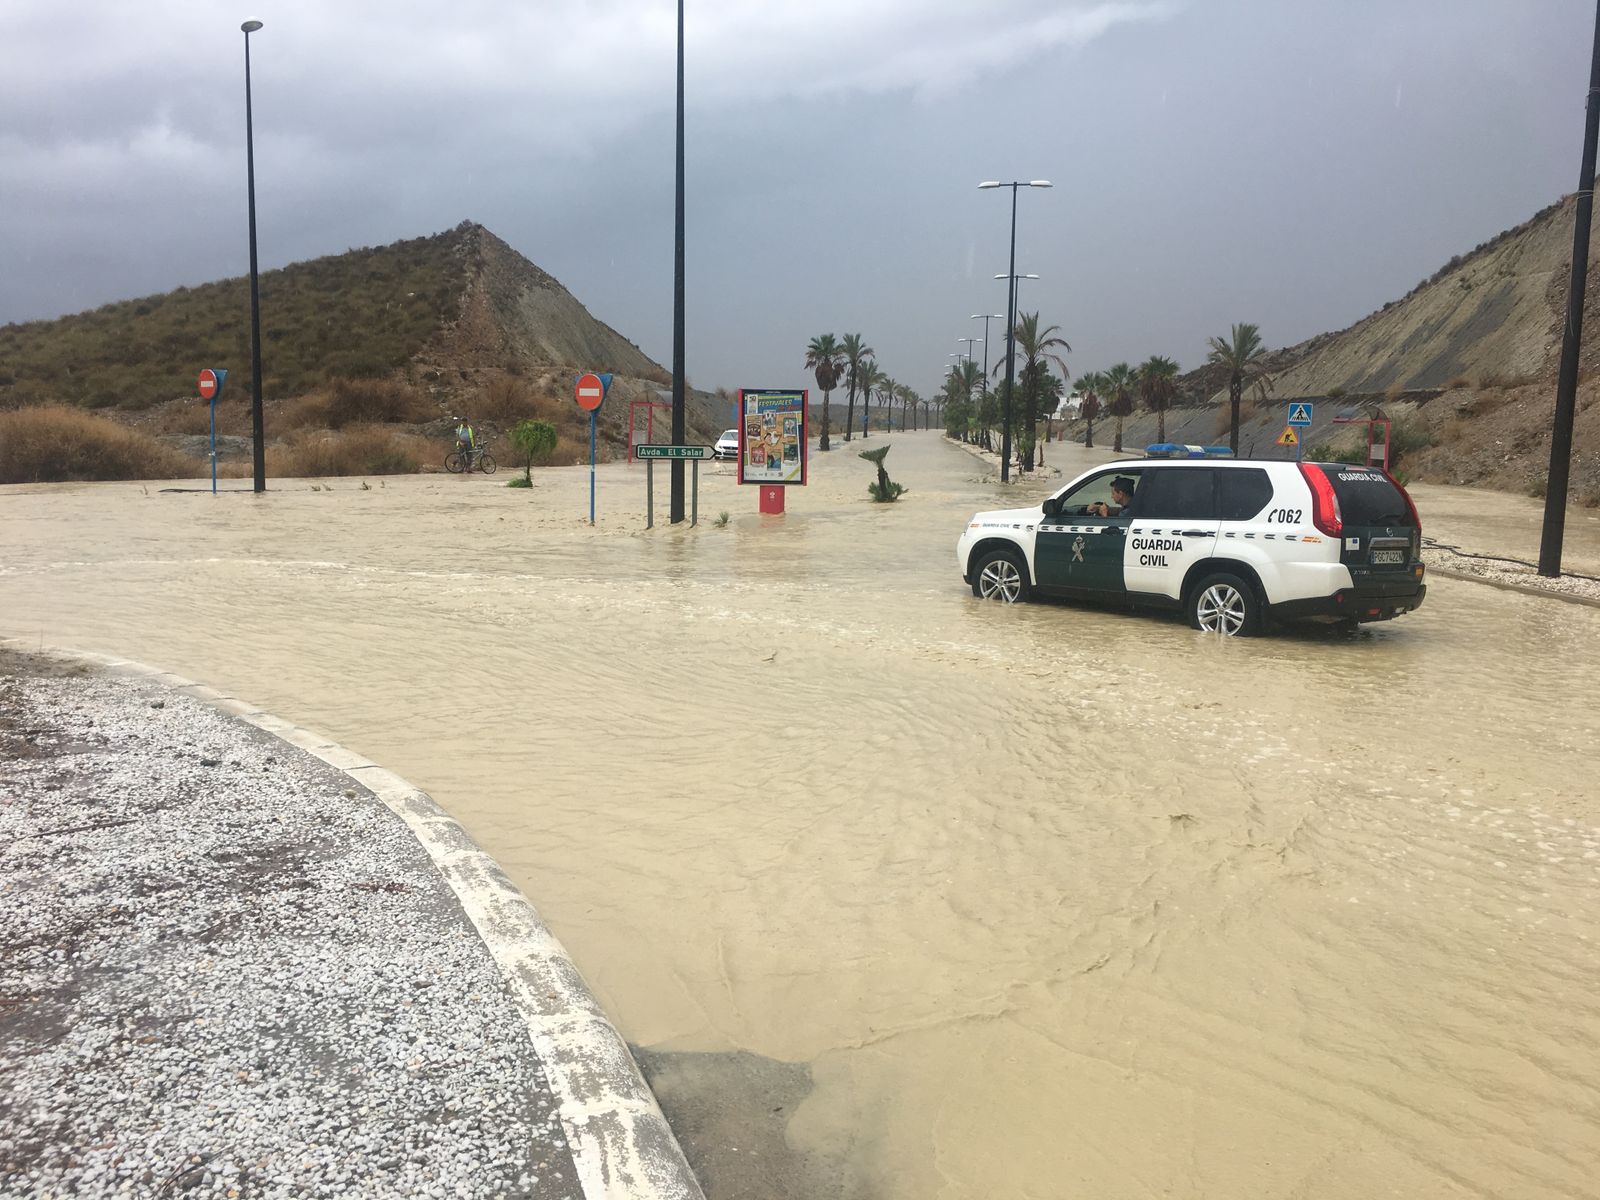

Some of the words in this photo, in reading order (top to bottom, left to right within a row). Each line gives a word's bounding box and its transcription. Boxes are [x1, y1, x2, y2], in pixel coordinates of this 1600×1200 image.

[640, 448, 663, 456] Avda.
[667, 448, 676, 456] El
[681, 448, 703, 456] Salar
[1337, 472, 1372, 482] GUARDIA
[1369, 473, 1388, 483] CIVIL
[1277, 508, 1303, 524] 062
[1132, 538, 1183, 552] GUARDIA
[1140, 554, 1168, 567] CIVIL
